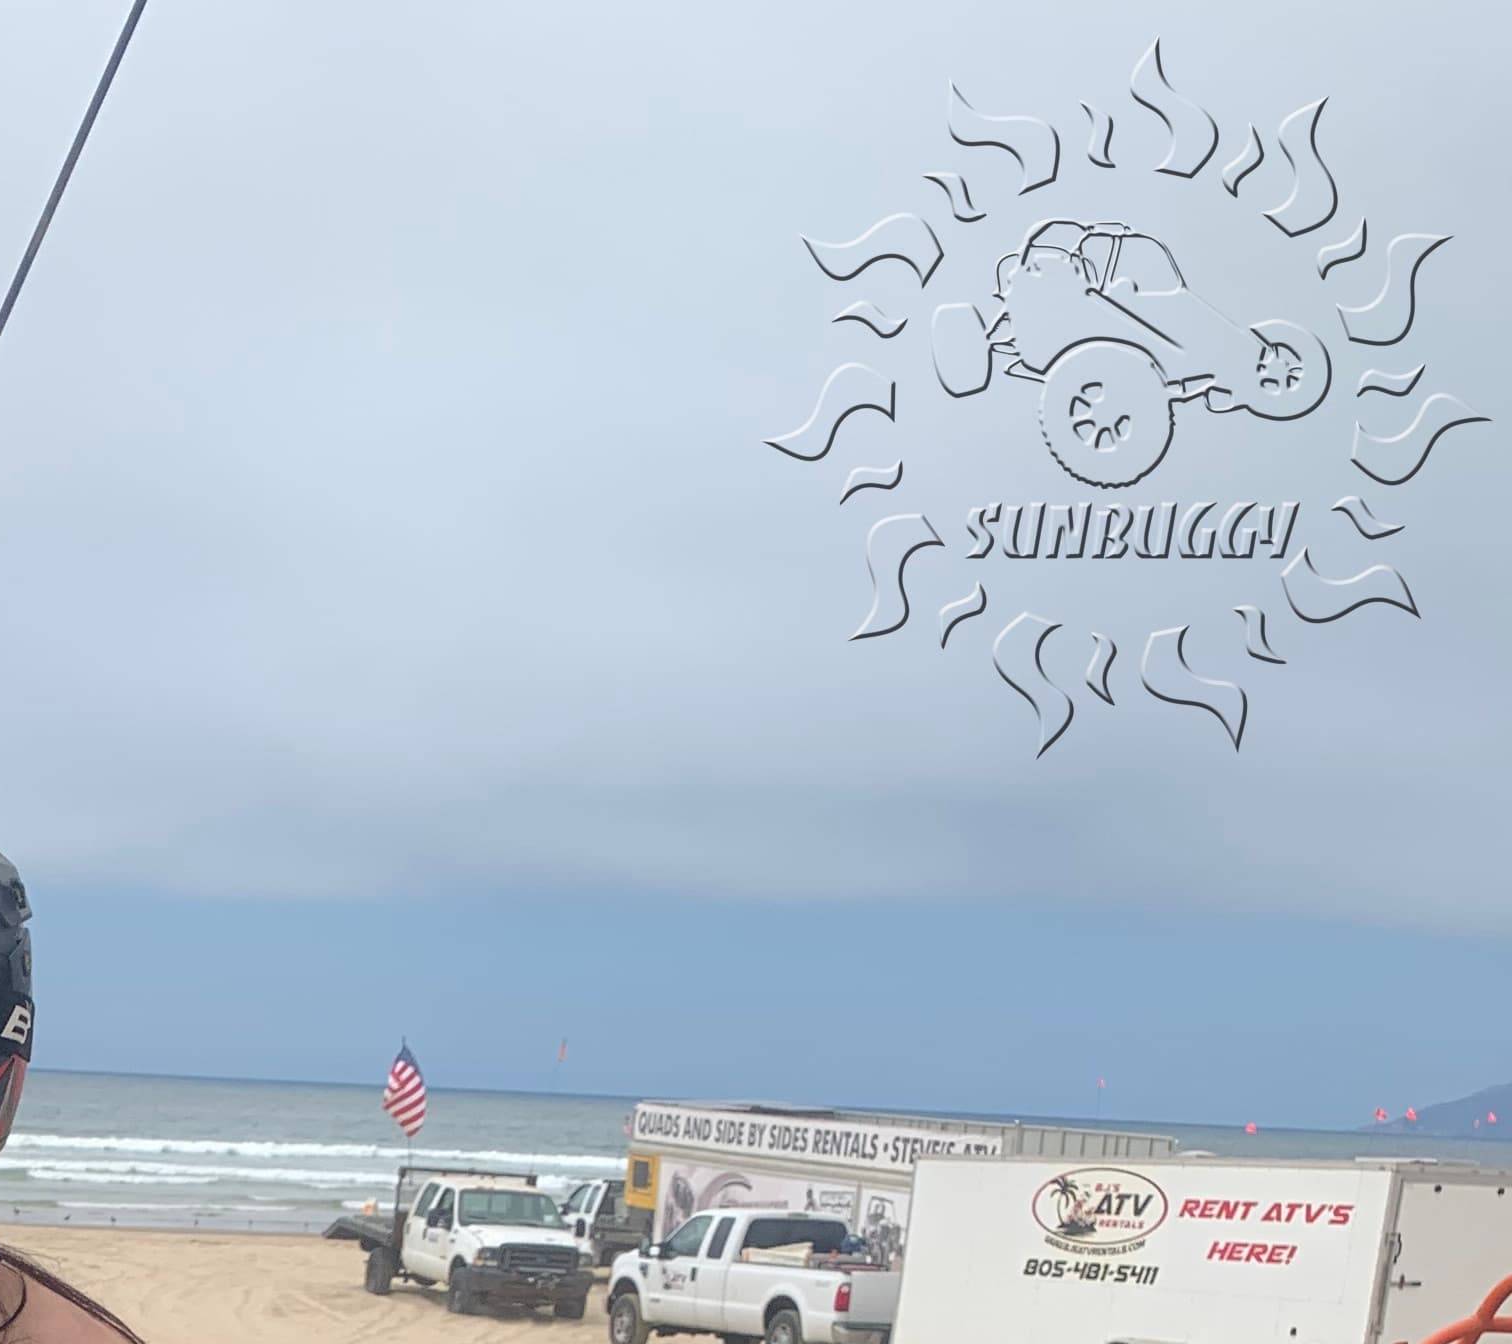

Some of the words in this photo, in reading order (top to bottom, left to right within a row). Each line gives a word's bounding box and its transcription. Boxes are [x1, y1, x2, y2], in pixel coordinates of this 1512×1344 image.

[638, 1111, 681, 1139] QUADS
[682, 1114, 712, 1142] AND
[713, 1119, 745, 1146] SIDE
[747, 1122, 767, 1149] BY
[768, 1124, 809, 1153] SIDES
[812, 1128, 879, 1161] RENTALS
[1094, 1193, 1154, 1217] ATV
[1178, 1198, 1259, 1221] RENT
[1260, 1202, 1355, 1226] ATV'S
[1098, 1219, 1145, 1231] RENTALS
[1206, 1240, 1299, 1265] HERE!
[1023, 1258, 1160, 1286] 805-481-5411
